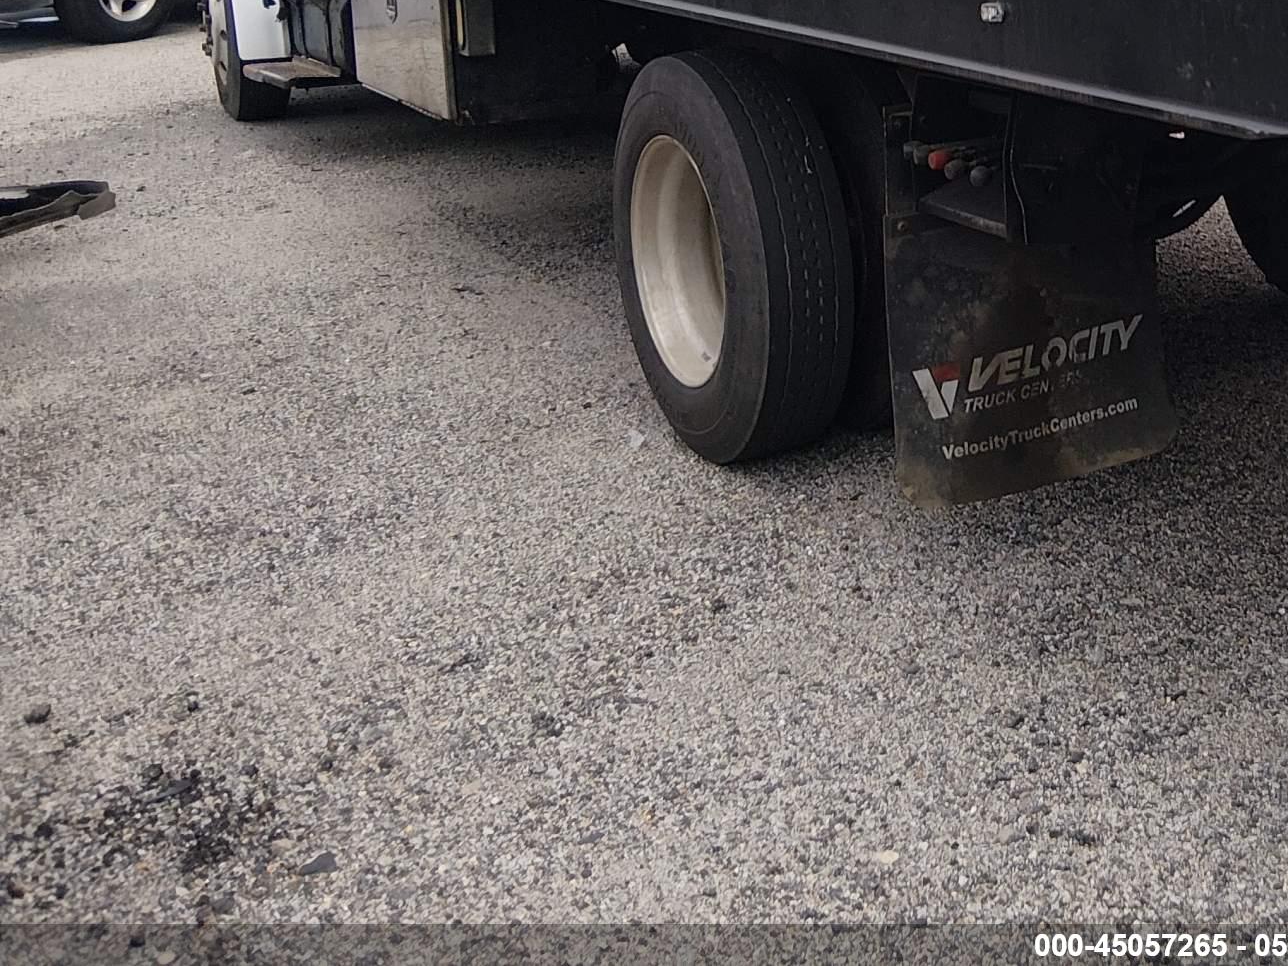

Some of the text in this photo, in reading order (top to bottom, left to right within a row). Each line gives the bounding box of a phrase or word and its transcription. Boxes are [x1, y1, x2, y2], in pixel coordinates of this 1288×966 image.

[968, 314, 1143, 392] VELOCITY
[941, 397, 1138, 460] VelocityTruckCenters.com
[963, 393, 1016, 415] TRUCK
